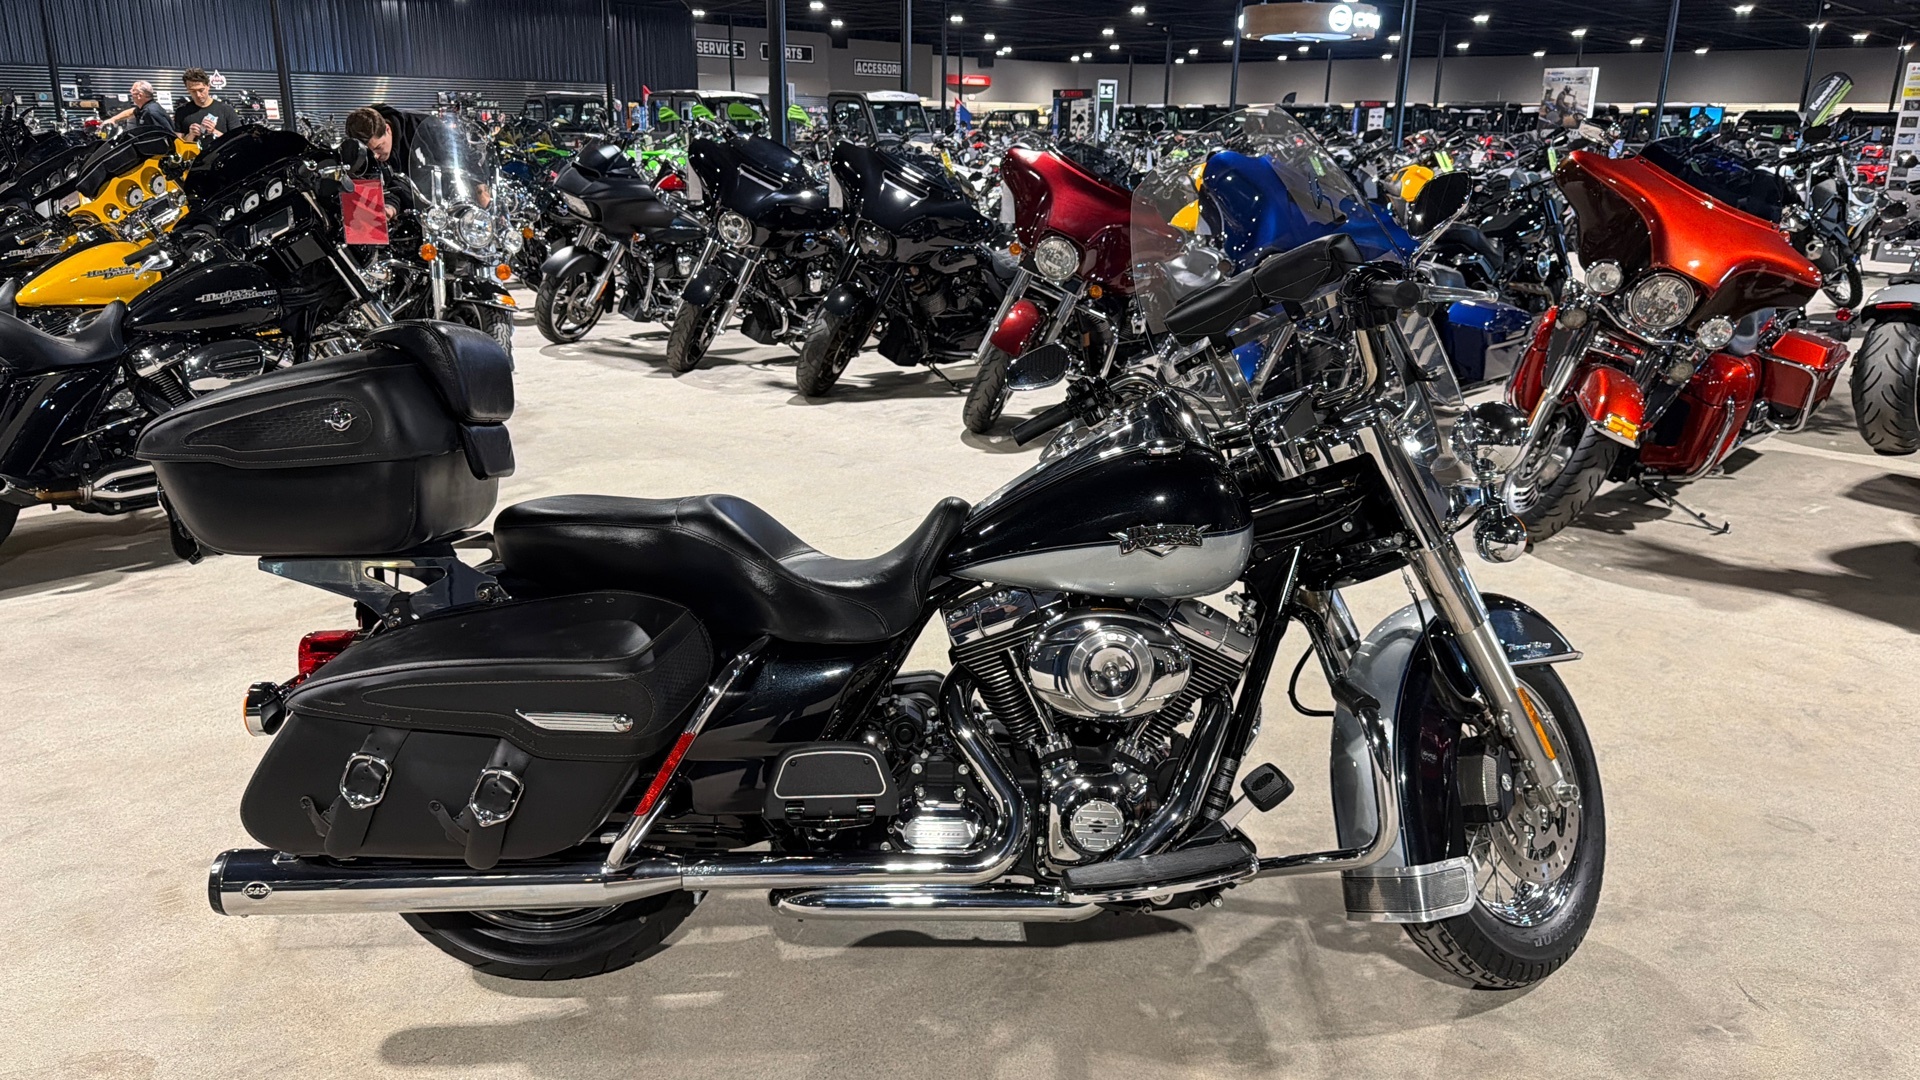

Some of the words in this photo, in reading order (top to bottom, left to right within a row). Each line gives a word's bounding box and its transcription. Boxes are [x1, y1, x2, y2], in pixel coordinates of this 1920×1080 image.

[697, 41, 738, 55] SERVICE
[856, 62, 901, 75] ACCESSORI
[246, 887, 266, 895] S&S
